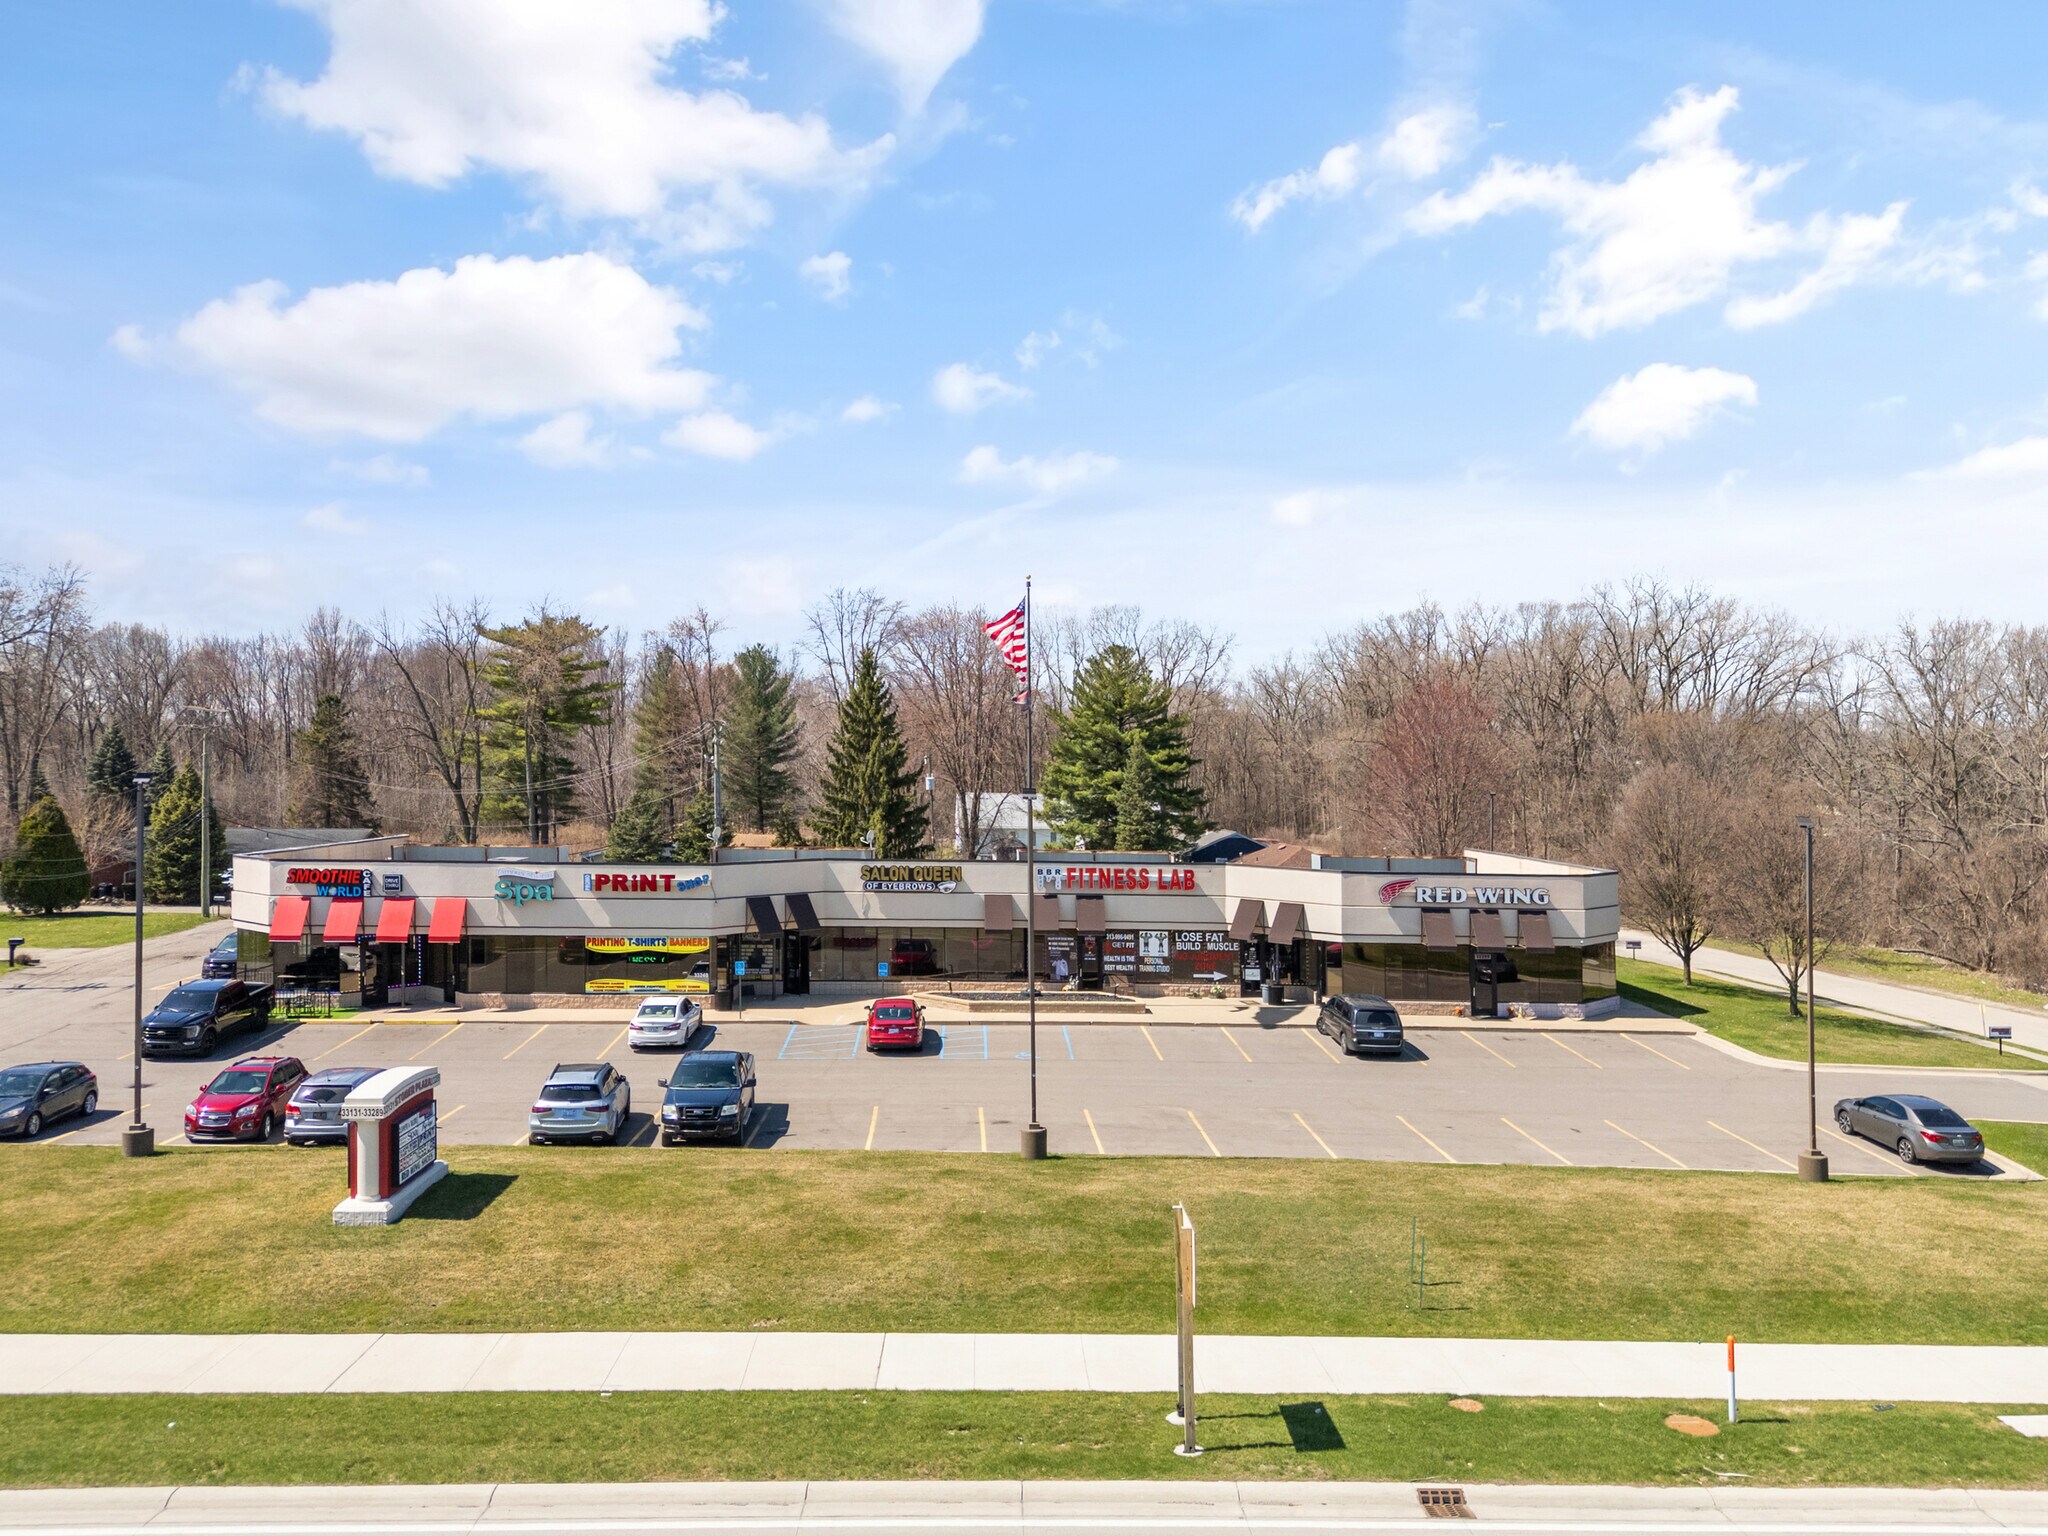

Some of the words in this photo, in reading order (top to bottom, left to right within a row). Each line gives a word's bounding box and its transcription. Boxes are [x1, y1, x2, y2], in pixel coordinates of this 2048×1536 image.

[287, 868, 361, 884] SMOOTHIE
[860, 865, 909, 881] SALON
[913, 866, 963, 882] QUEEN
[1066, 867, 1150, 891] FITNESS
[1157, 869, 1196, 891] LAB
[362, 869, 372, 896] CAFE
[676, 874, 709, 892] SHOP
[495, 879, 553, 906] Spa
[1415, 887, 1468, 903] RED
[1474, 887, 1550, 905] WING
[586, 938, 625, 946] PRINTING
[628, 938, 667, 946] T-SHIRTS
[669, 938, 708, 946] BANNERS
[1175, 933, 1203, 942] LOSE
[1206, 933, 1224, 942] FAT
[1176, 942, 1201, 950] BUILD
[1207, 943, 1239, 951] MUSCLE
